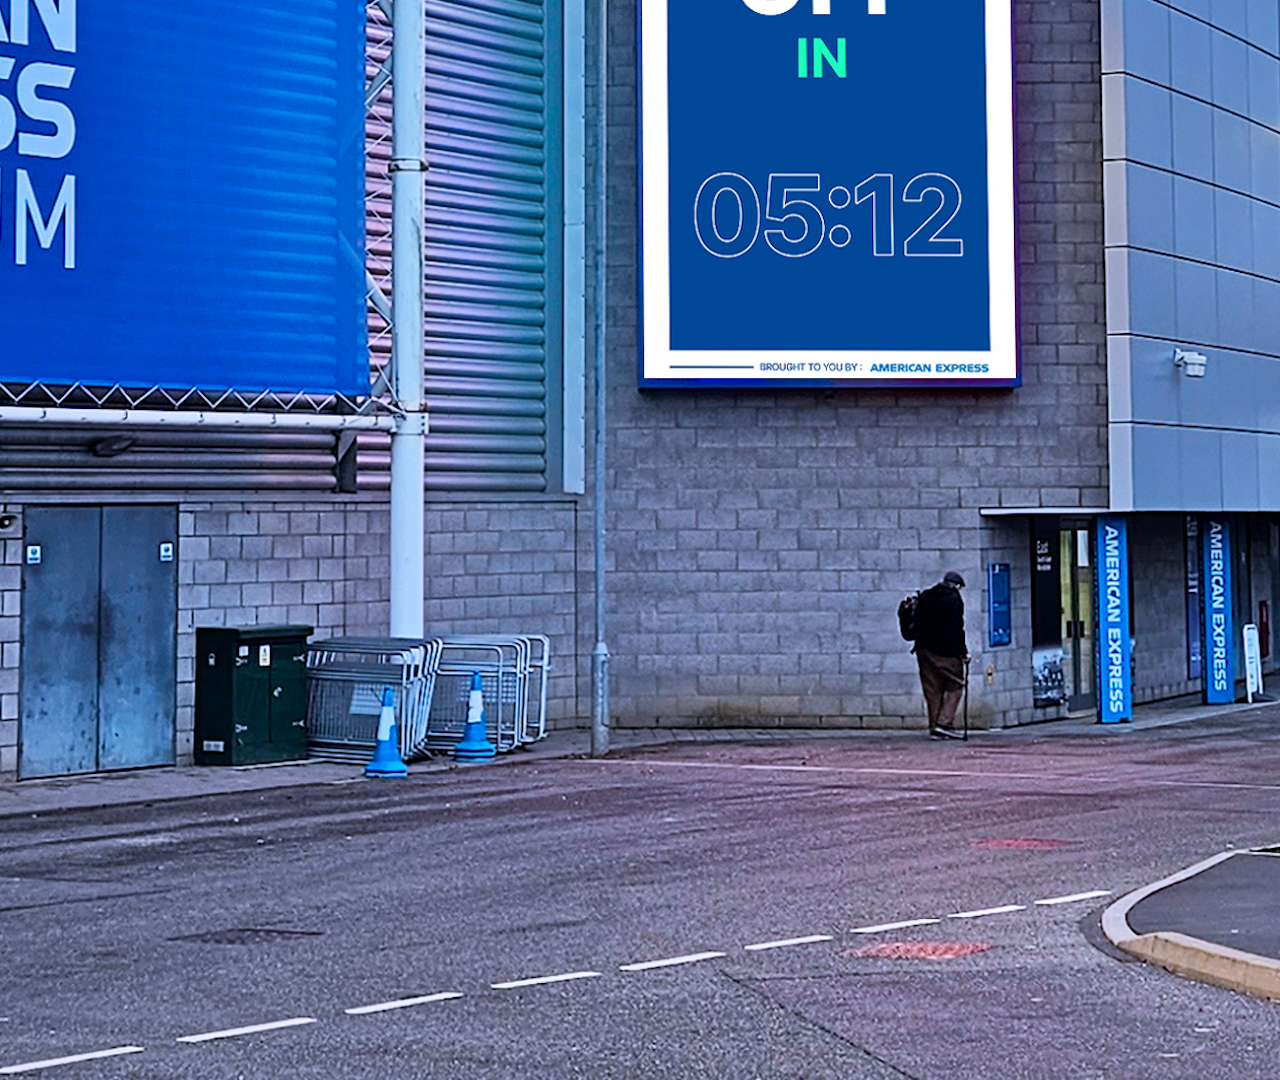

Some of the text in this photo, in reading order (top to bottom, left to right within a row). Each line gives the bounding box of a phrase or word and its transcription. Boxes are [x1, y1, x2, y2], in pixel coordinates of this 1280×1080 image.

[798, 37, 847, 78] IN
[693, 171, 964, 258] 05:12
[760, 362, 806, 372] BROUGHT
[808, 362, 821, 372] TO
[823, 362, 843, 372] YOU
[870, 363, 932, 373] AMERICAN
[935, 363, 990, 373] EXPRESS
[1105, 525, 1124, 713] AMERICAN EXPRESS
[1209, 521, 1228, 692] AMERICAN EXPRESS
